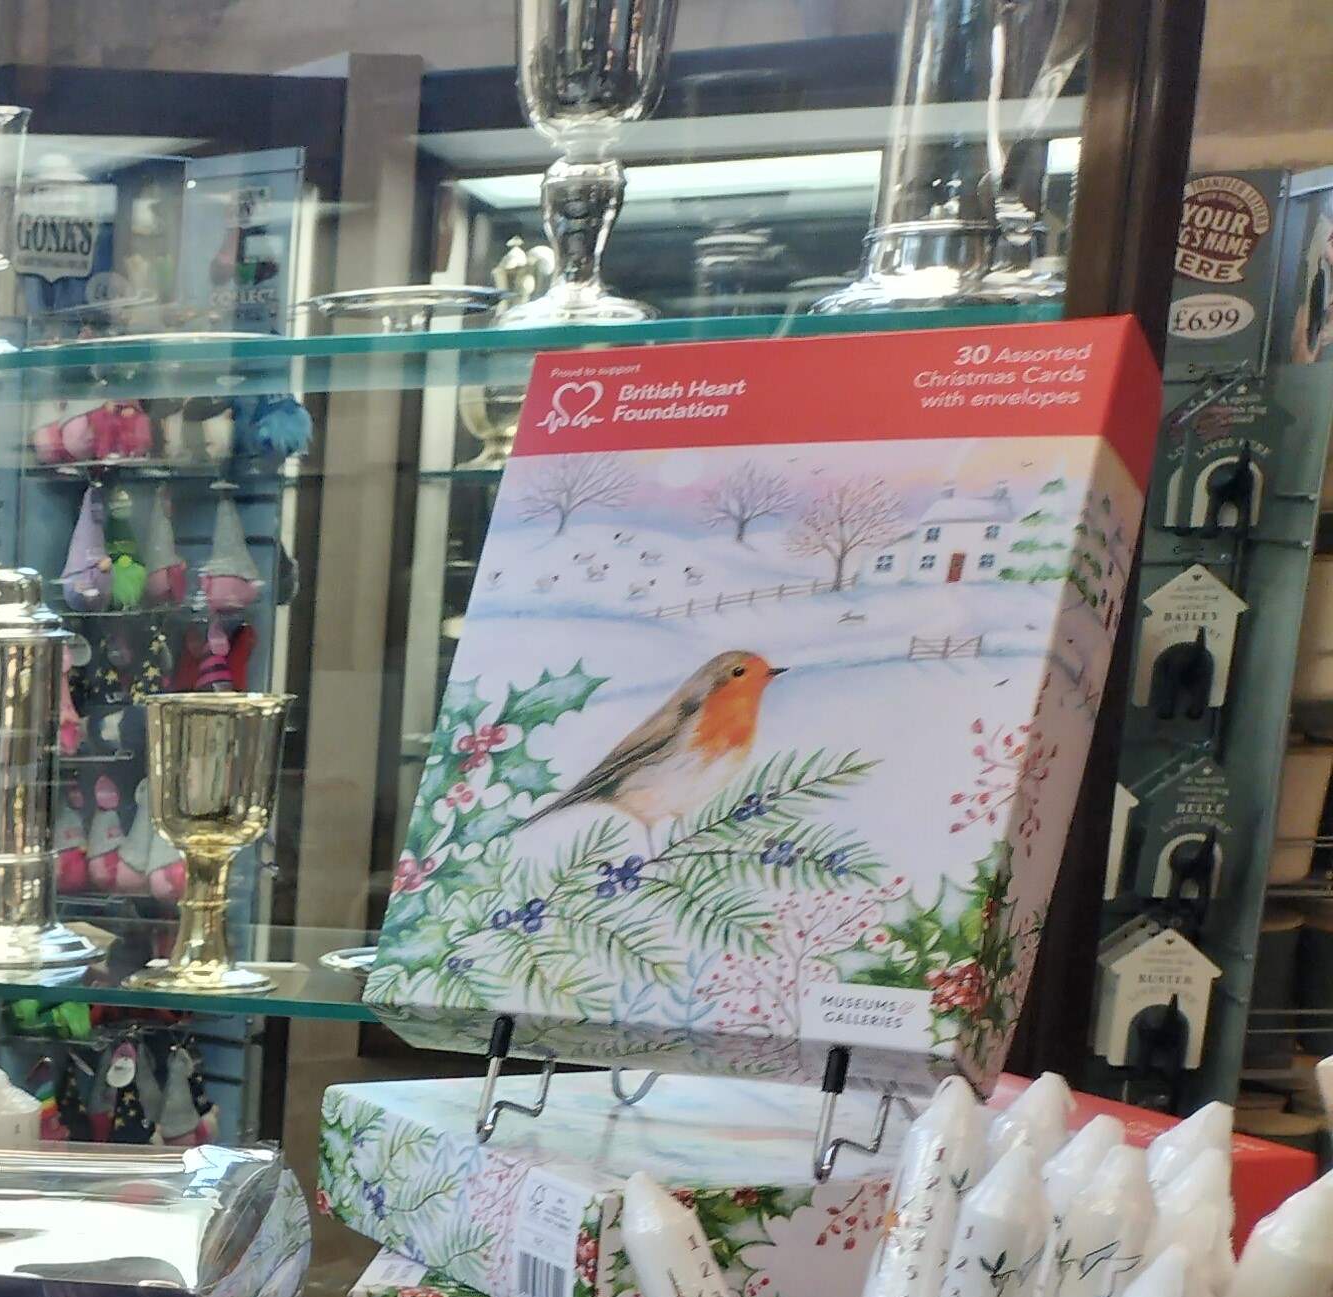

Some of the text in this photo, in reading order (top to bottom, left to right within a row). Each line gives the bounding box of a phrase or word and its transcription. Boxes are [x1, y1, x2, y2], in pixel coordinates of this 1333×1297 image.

[1181, 203, 1251, 235] YOUR
[17, 212, 93, 256] GONKS
[1203, 231, 1253, 258] NAME
[1179, 253, 1234, 279] ERE
[1174, 308, 1240, 332] £6.99
[954, 342, 1094, 366] 30 Assorted
[596, 364, 641, 378] support
[913, 364, 1087, 389] Christmas Cards
[618, 379, 747, 401] British Heart
[921, 387, 1081, 409] with envelopes
[612, 401, 729, 422] Foundation
[821, 996, 896, 1013] MUSEUMS
[823, 1011, 902, 1029] GALLERIES
